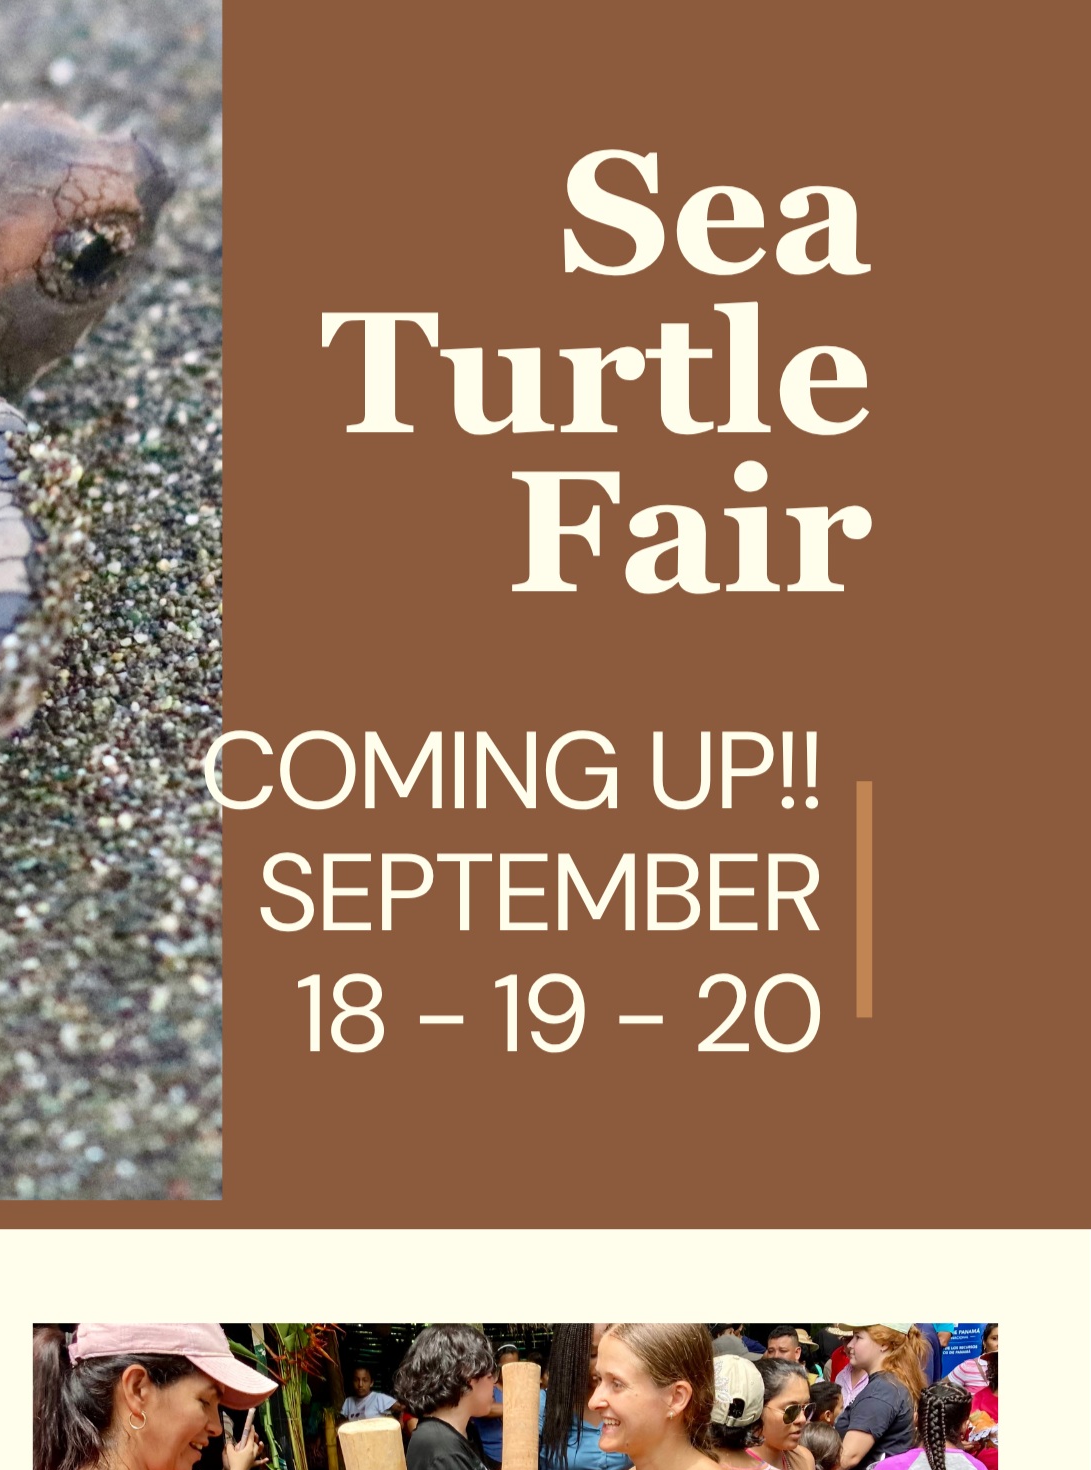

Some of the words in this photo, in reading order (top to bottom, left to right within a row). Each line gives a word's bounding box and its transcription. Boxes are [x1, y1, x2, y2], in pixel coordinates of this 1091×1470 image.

[564, 149, 871, 276] Sea
[322, 300, 869, 436] Turtle
[512, 460, 872, 594] Fair
[204, 730, 617, 810] COMING
[653, 731, 818, 810] UP!!
[260, 852, 820, 932] SEPTEMBER
[298, 973, 384, 1053] 18
[495, 973, 585, 1053] 19
[698, 973, 820, 1053] 20
